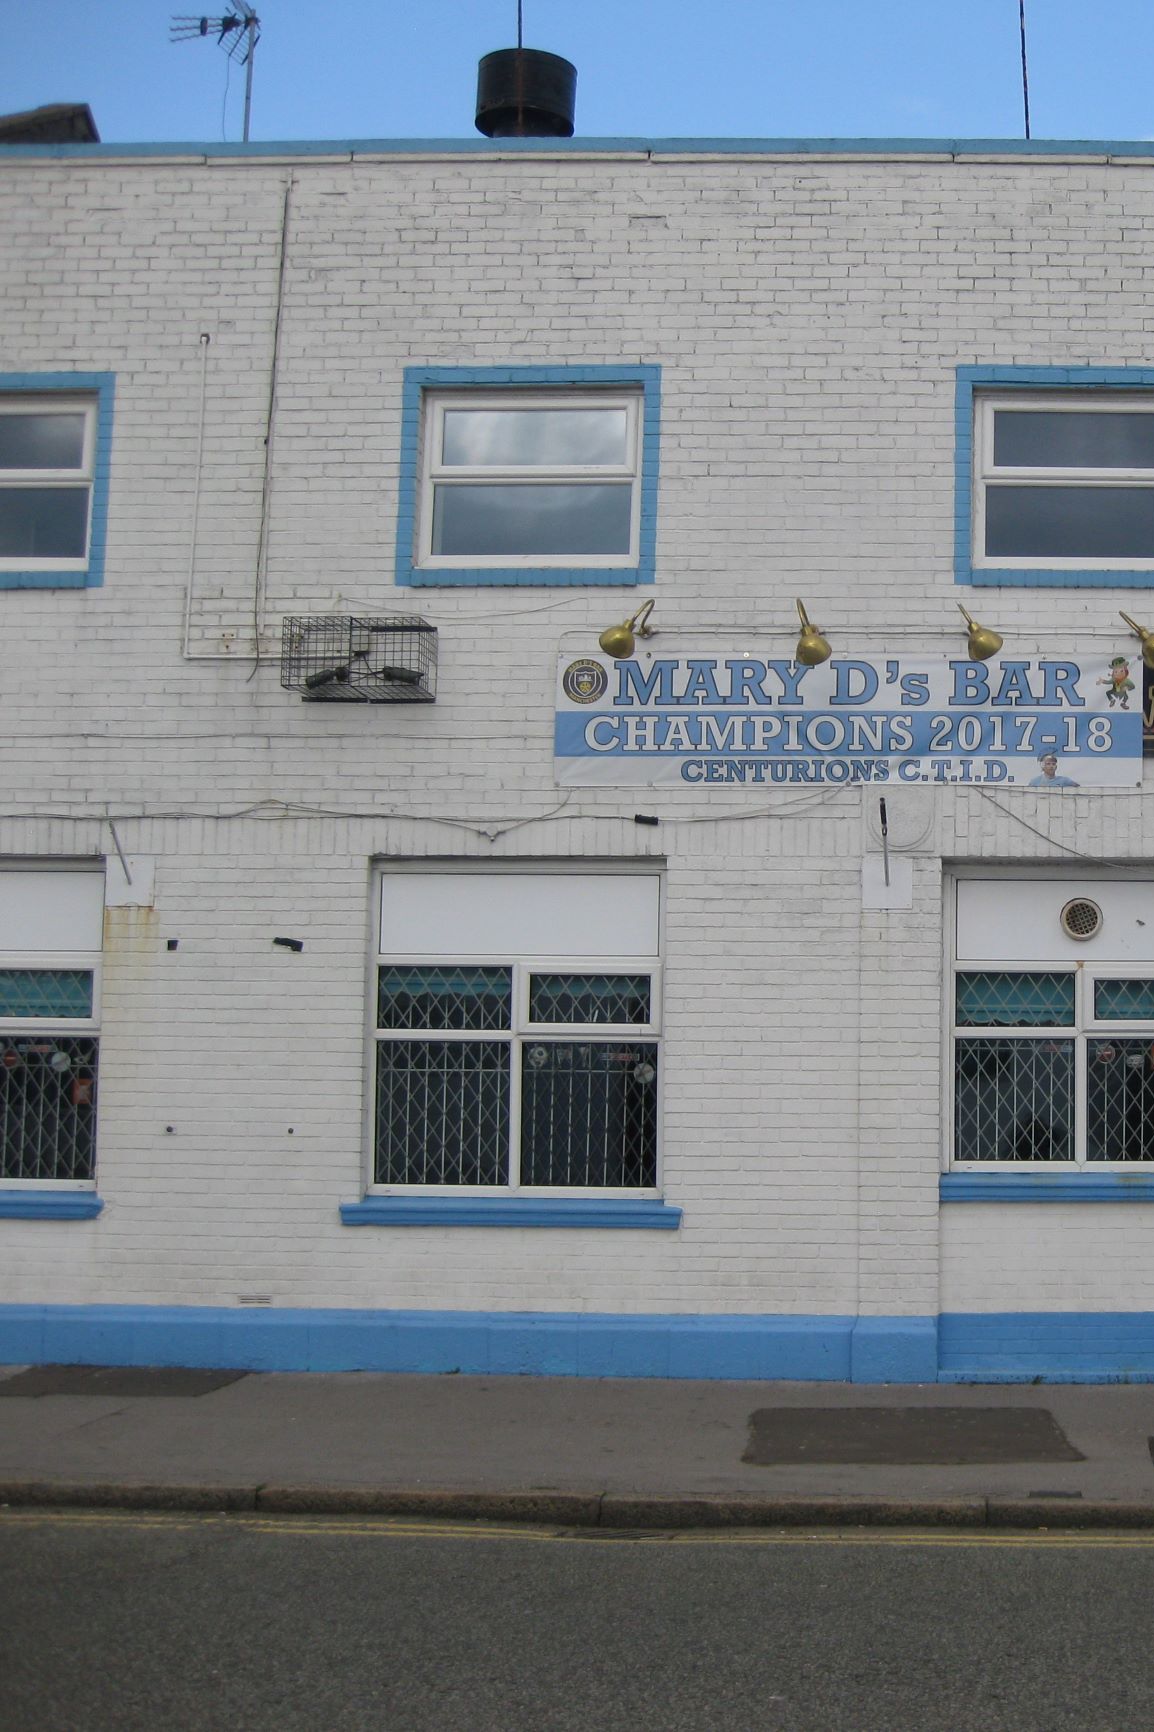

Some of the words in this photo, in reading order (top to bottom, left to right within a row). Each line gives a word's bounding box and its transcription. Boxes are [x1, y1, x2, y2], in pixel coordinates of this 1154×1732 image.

[613, 659, 815, 706] MARY
[948, 660, 1086, 707] BAR
[583, 714, 915, 752] CHAMPIONS
[928, 715, 1113, 753] 2017-18
[680, 759, 890, 783] CENTURIONS
[897, 759, 1015, 783] C.T.I.D.
